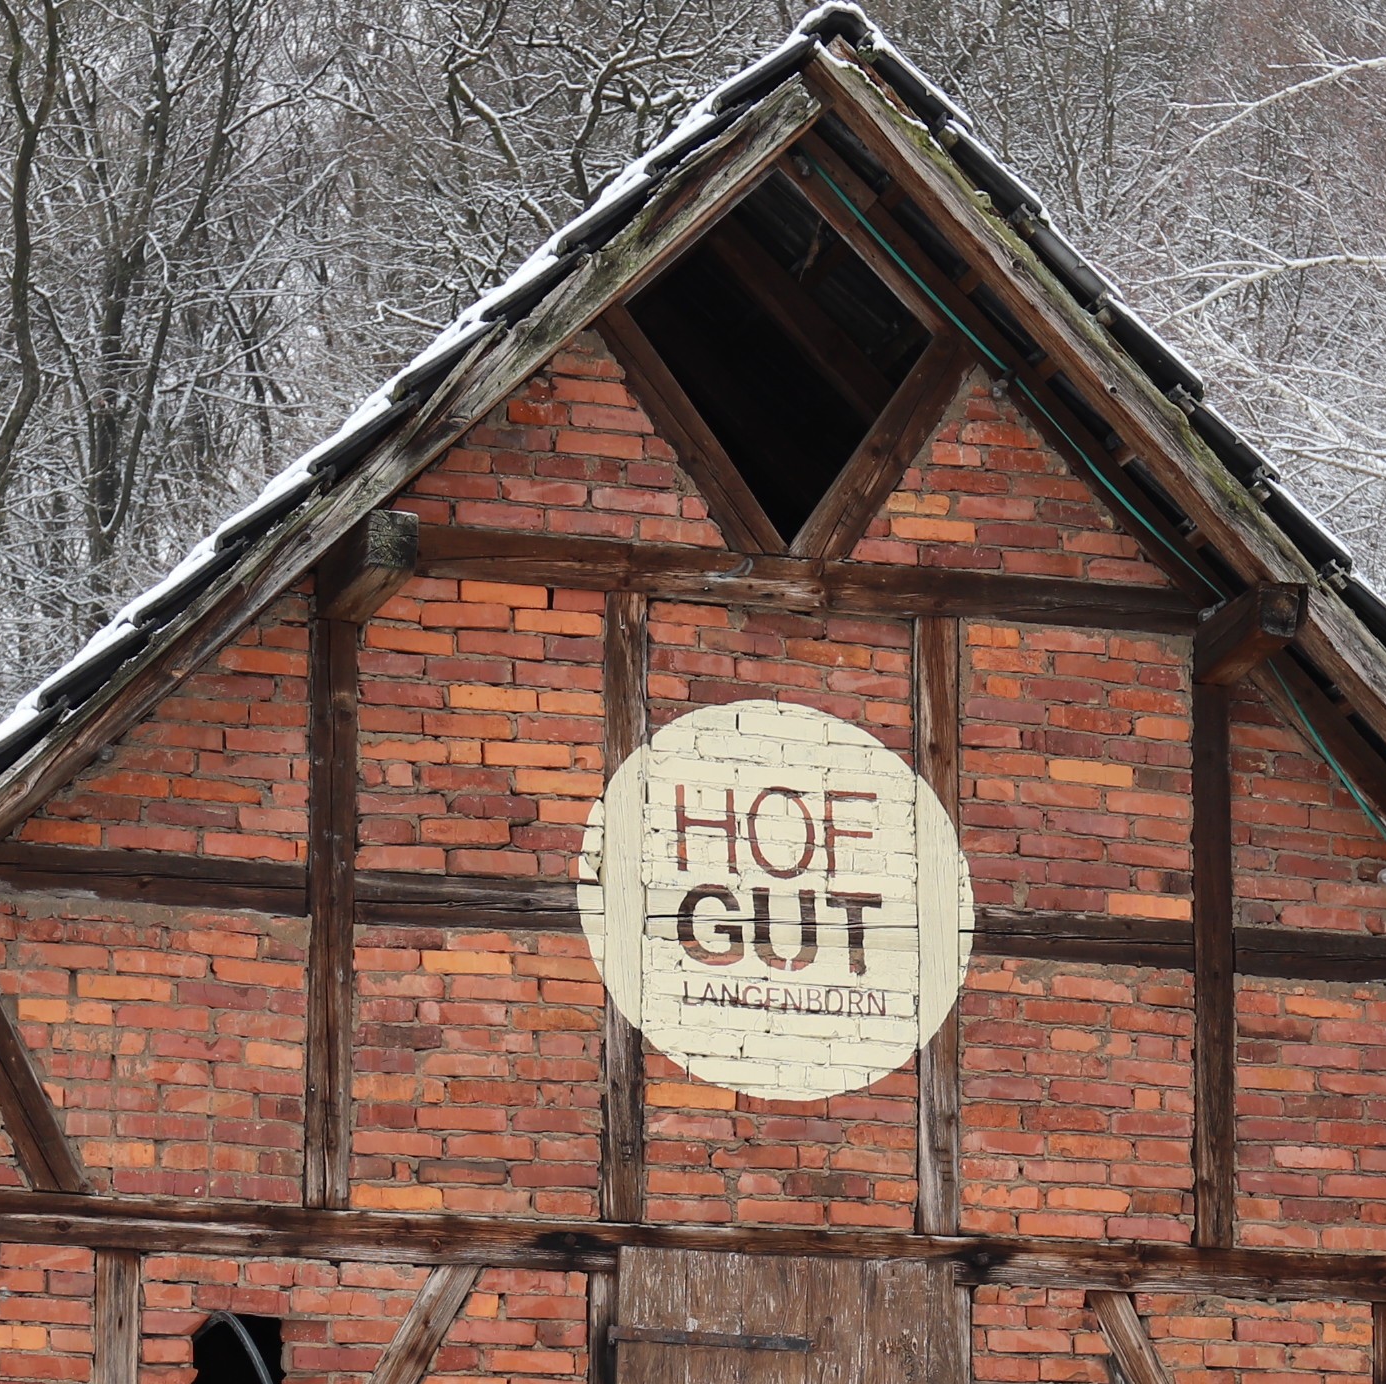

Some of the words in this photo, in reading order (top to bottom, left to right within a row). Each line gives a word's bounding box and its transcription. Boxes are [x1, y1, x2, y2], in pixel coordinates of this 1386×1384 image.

[675, 784, 877, 878] HOF
[677, 884, 882, 974] GUT
[682, 980, 887, 1016] LANGENBORN
